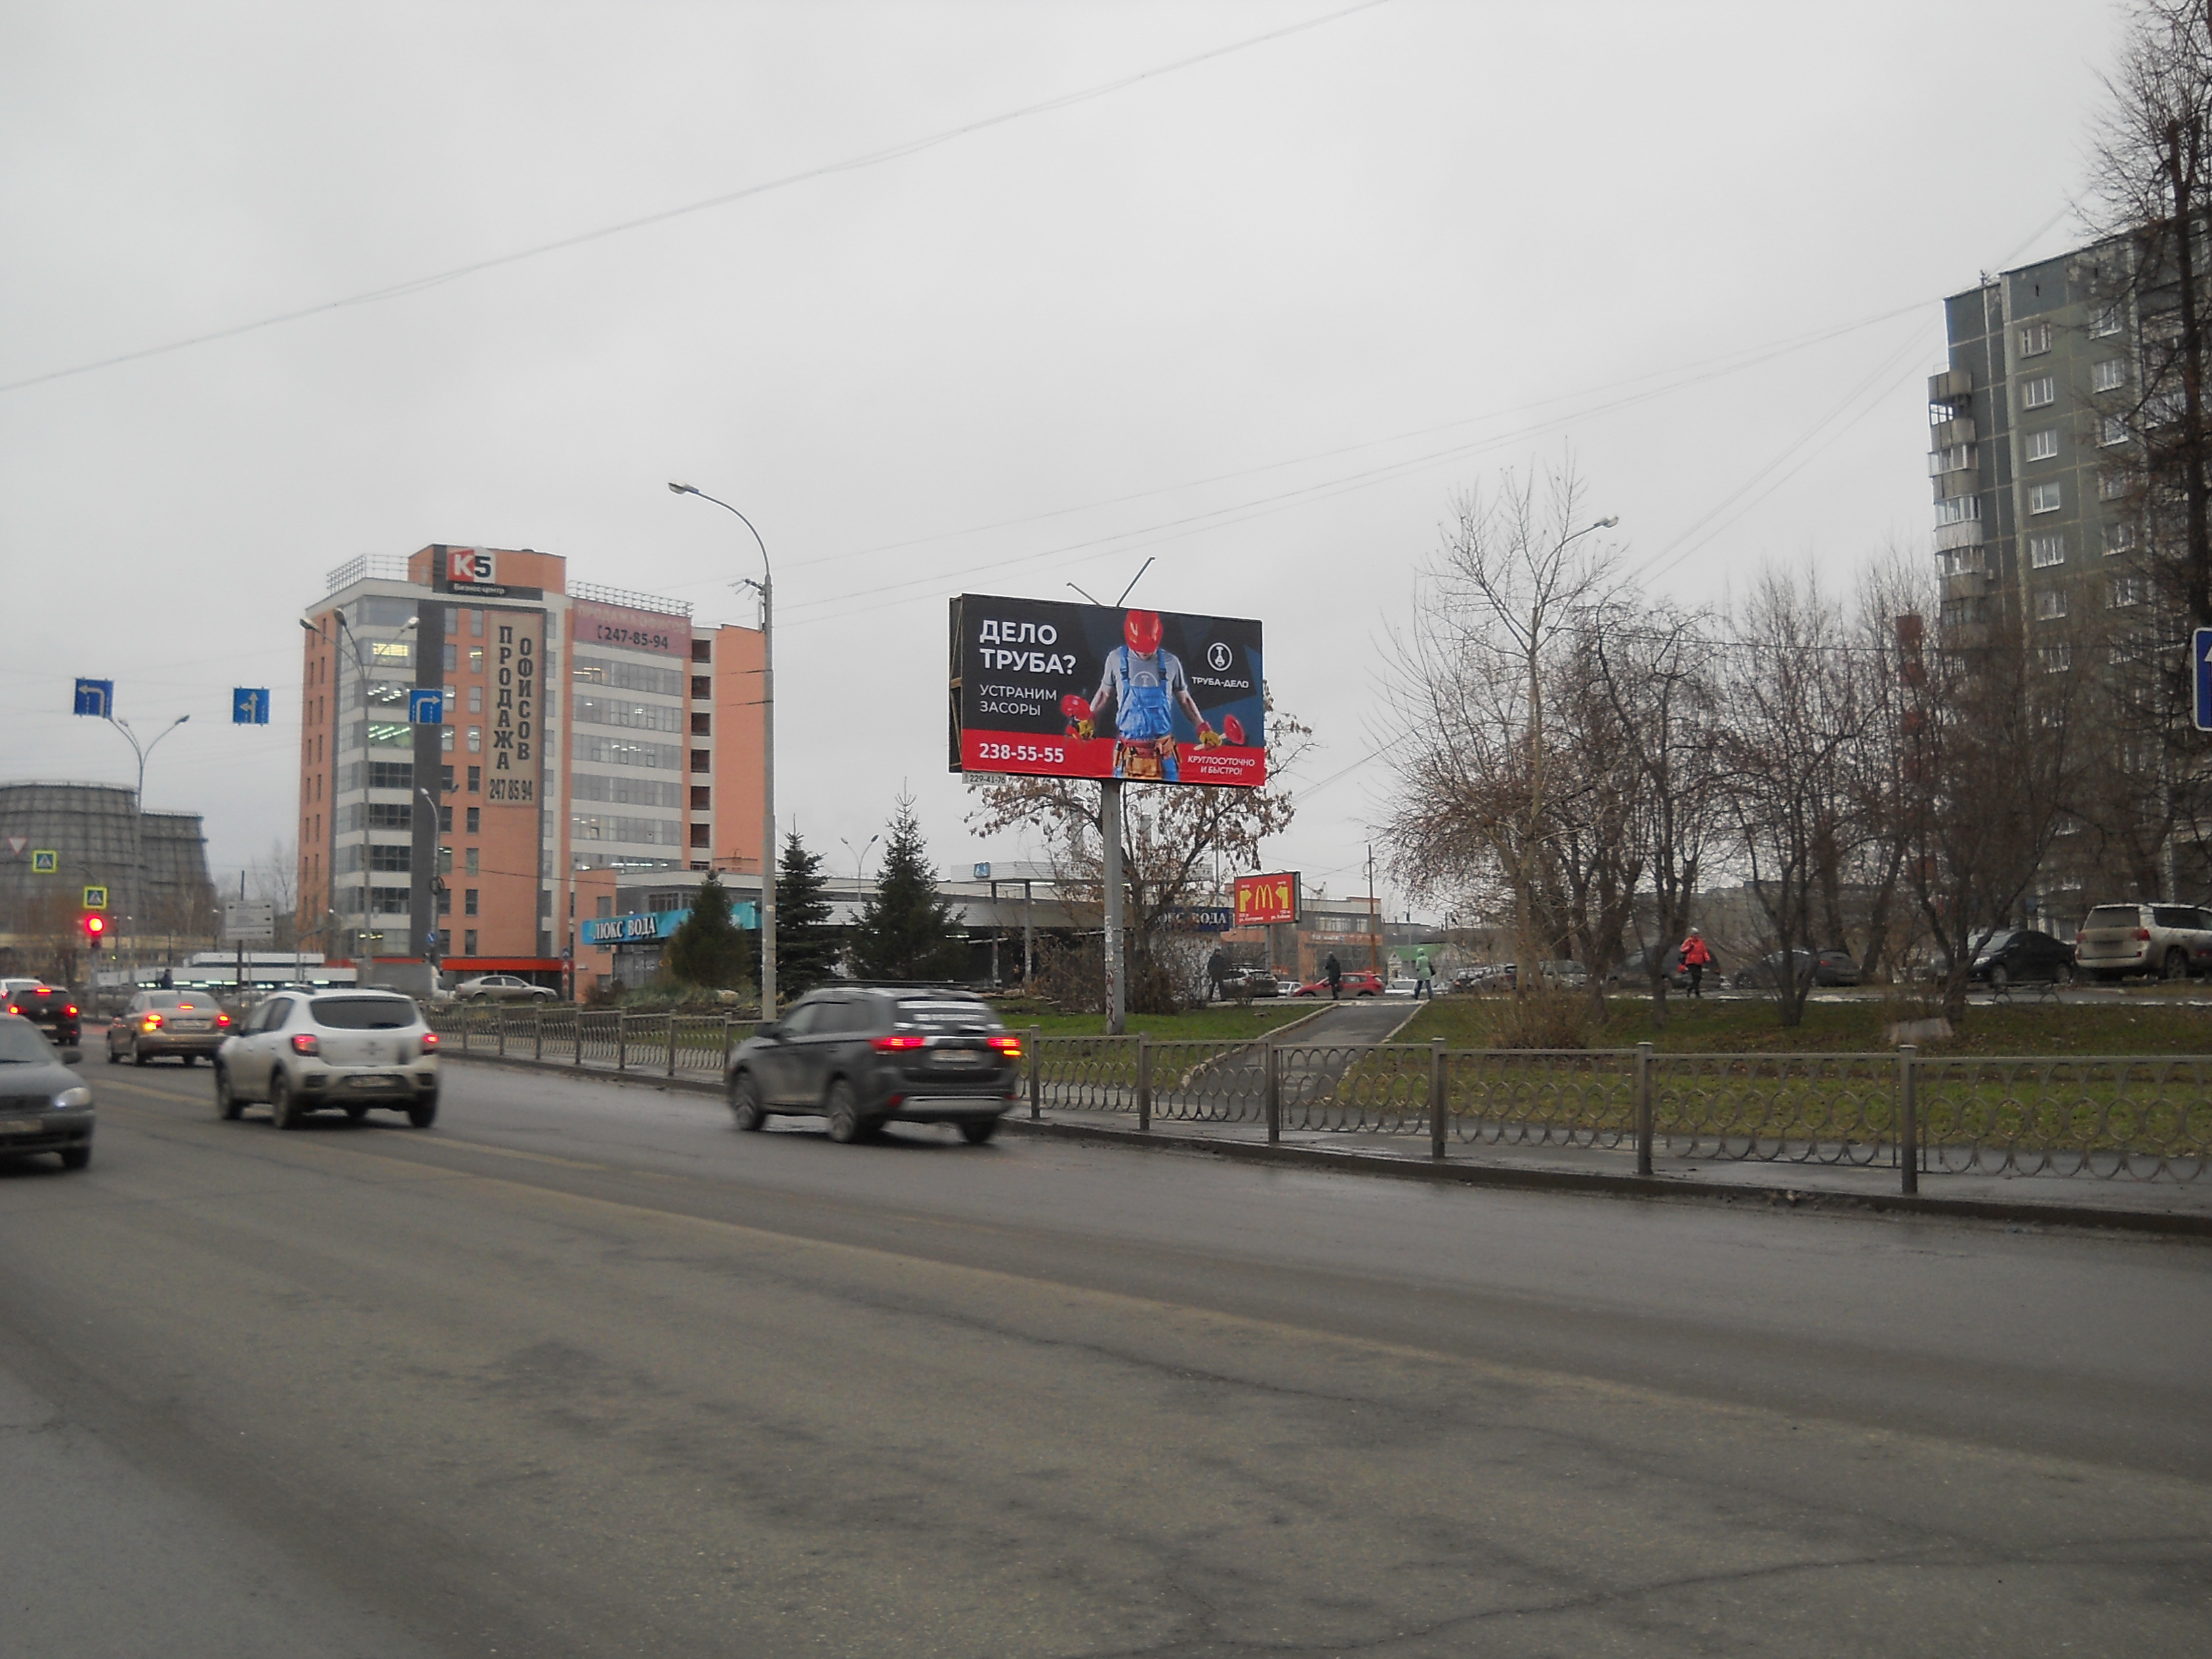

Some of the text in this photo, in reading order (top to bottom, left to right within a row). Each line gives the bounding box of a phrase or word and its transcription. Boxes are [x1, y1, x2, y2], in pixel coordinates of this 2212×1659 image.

[605, 626, 668, 649] 247-85-94
[979, 620, 1057, 645] ДЕЛО
[979, 648, 1077, 675] ТРУБА?
[980, 684, 1057, 701] УСТРАНИМ
[1191, 676, 1249, 689] ТРУБА-ДЕЛО
[493, 626, 514, 770] ПРОДАЖА
[517, 638, 533, 760] ОФИСОВ
[980, 700, 1042, 716] ЗАСОРЫ
[979, 743, 1065, 763] 238-55-55
[1188, 756, 1256, 766] КРУГЛОСУТОЧНО
[970, 775, 1006, 784] 229-41-76
[1208, 766, 1243, 775] БЫСТРО!
[489, 779, 533, 801] 247 85 94
[594, 917, 656, 939] ЛЮКС ВОДА
